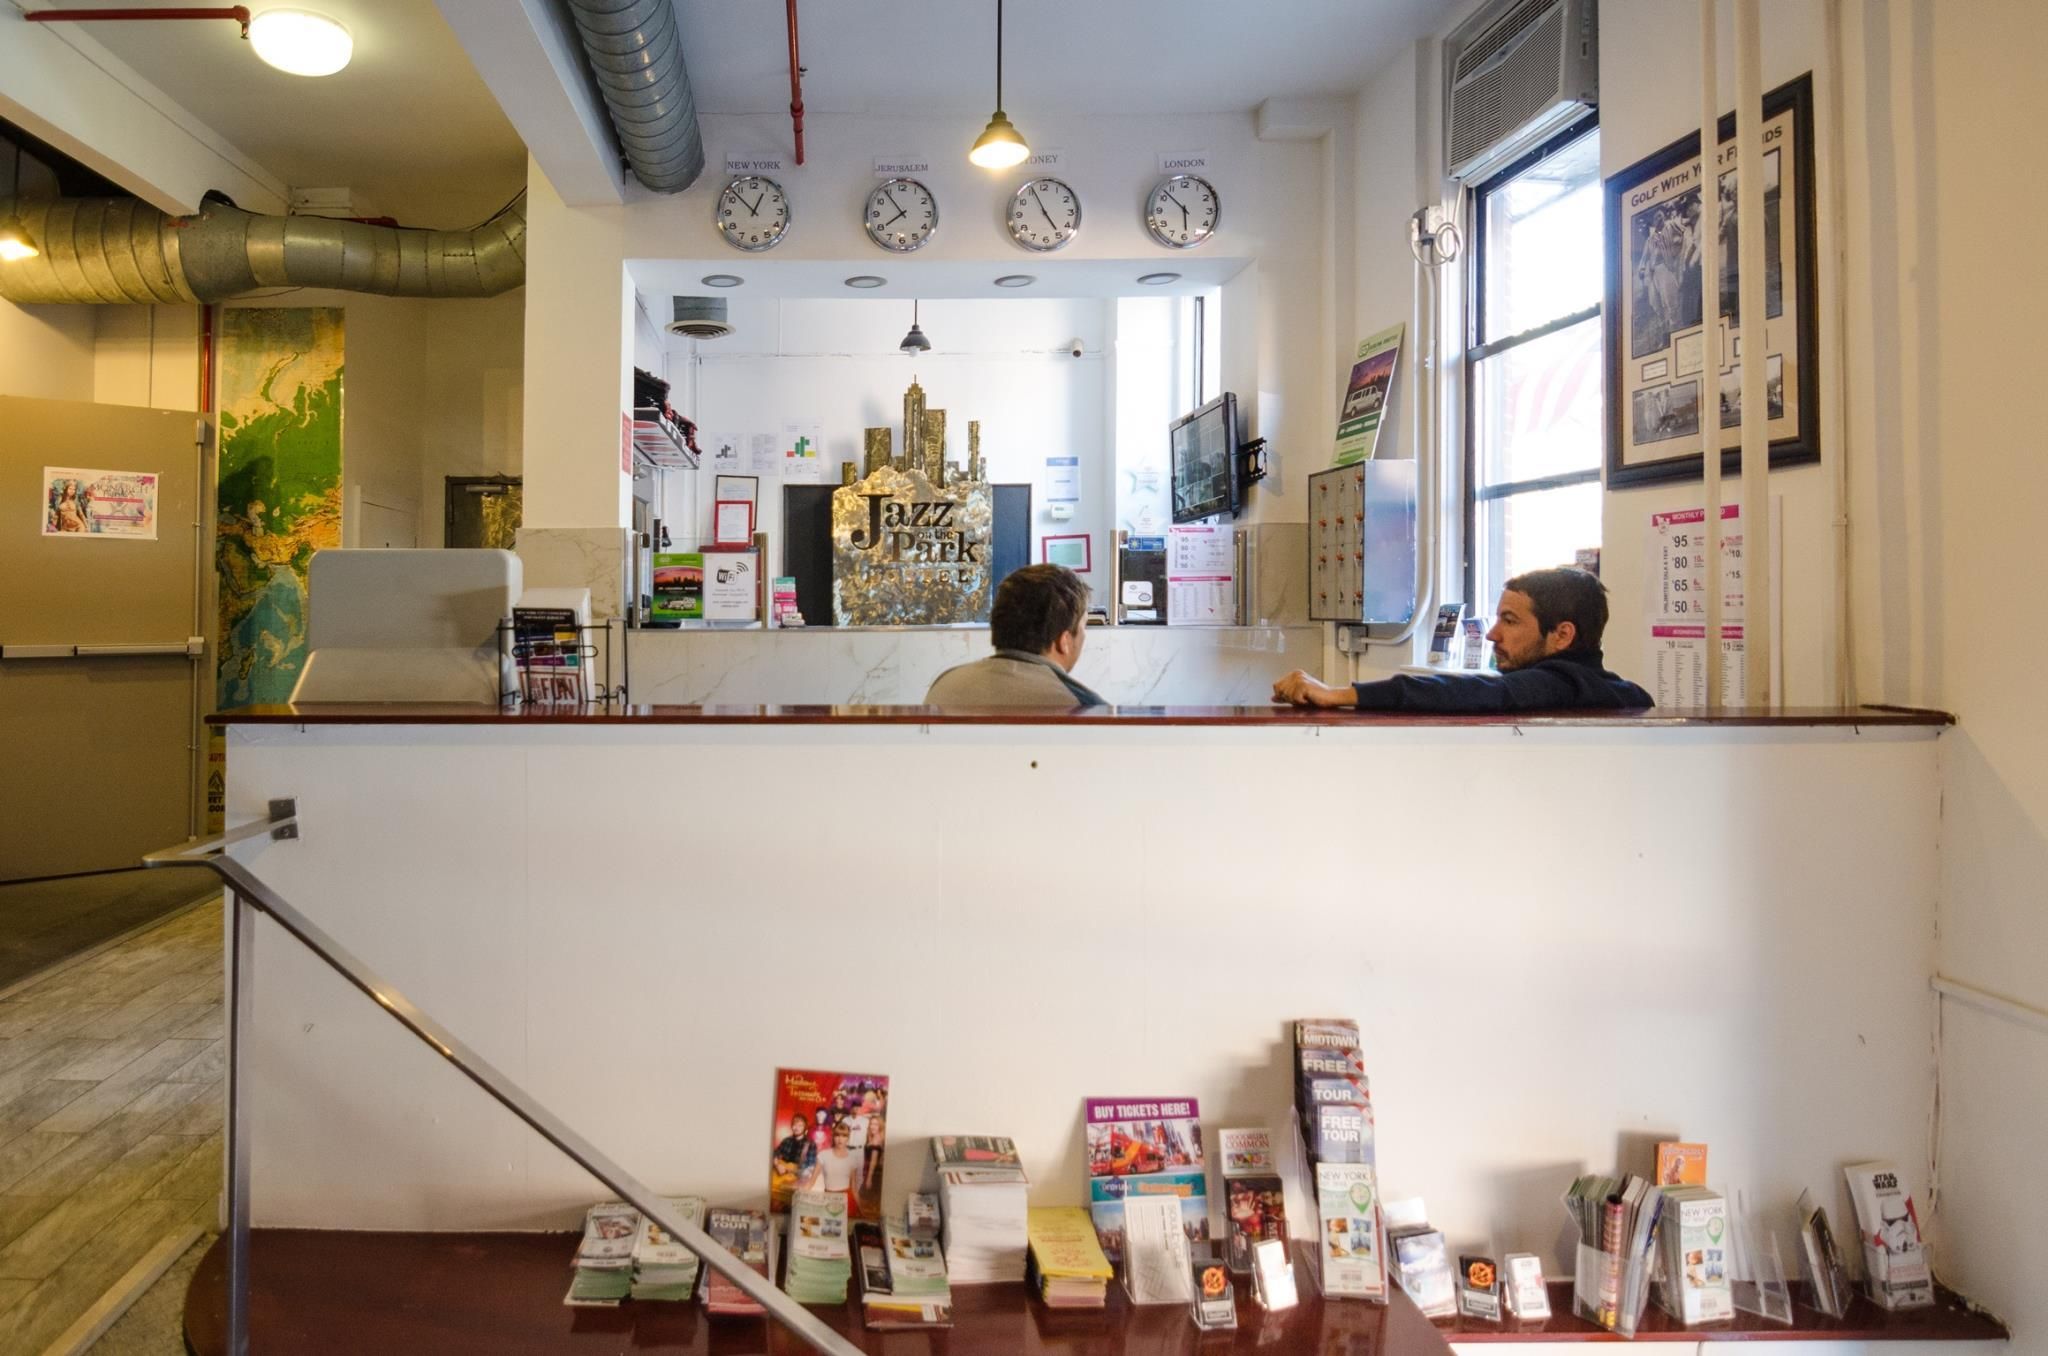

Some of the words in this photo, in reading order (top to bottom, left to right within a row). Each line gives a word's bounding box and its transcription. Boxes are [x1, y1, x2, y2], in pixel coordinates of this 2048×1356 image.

[727, 161, 750, 169] NEW
[753, 161, 780, 169] YORK
[1164, 159, 1205, 168] LONDON
[874, 164, 928, 172] JERUSALEM
[749, 182, 759, 190] 12
[1180, 181, 1189, 189] 12
[1631, 186, 1659, 207] GOLF
[1660, 171, 1689, 193] WITH
[728, 196, 736, 204] 10
[920, 197, 928, 205] 2
[1202, 194, 1210, 202] 2
[777, 208, 784, 216] 3
[872, 210, 880, 218] 9
[924, 210, 932, 218] 3
[1016, 211, 1023, 219] 9
[1160, 220, 1168, 228] 8
[738, 232, 745, 240] 7
[751, 235, 758, 243] 6
[764, 231, 771, 239] 5
[886, 233, 893, 241] 7
[851, 493, 954, 551] Jazz
[934, 529, 953, 540] the
[888, 530, 978, 563] Park
[1304, 1033, 1357, 1048] MIDTOWN
[1303, 1058, 1347, 1073] FREE
[1314, 1089, 1352, 1101] TOUR
[1094, 1105, 1114, 1119] BUY
[1118, 1103, 1159, 1118] TICKETS
[1160, 1102, 1191, 1116] HERE!
[1321, 1116, 1361, 1130] FREE
[1321, 1129, 1359, 1142] TOUR
[1320, 1171, 1341, 1180] NEW
[1344, 1170, 1369, 1180] YORK
[1874, 1173, 1897, 1182] STAR
[1873, 1180, 1898, 1190] WARS
[1681, 1208, 1700, 1217] NEW
[1703, 1206, 1724, 1216] YORK
